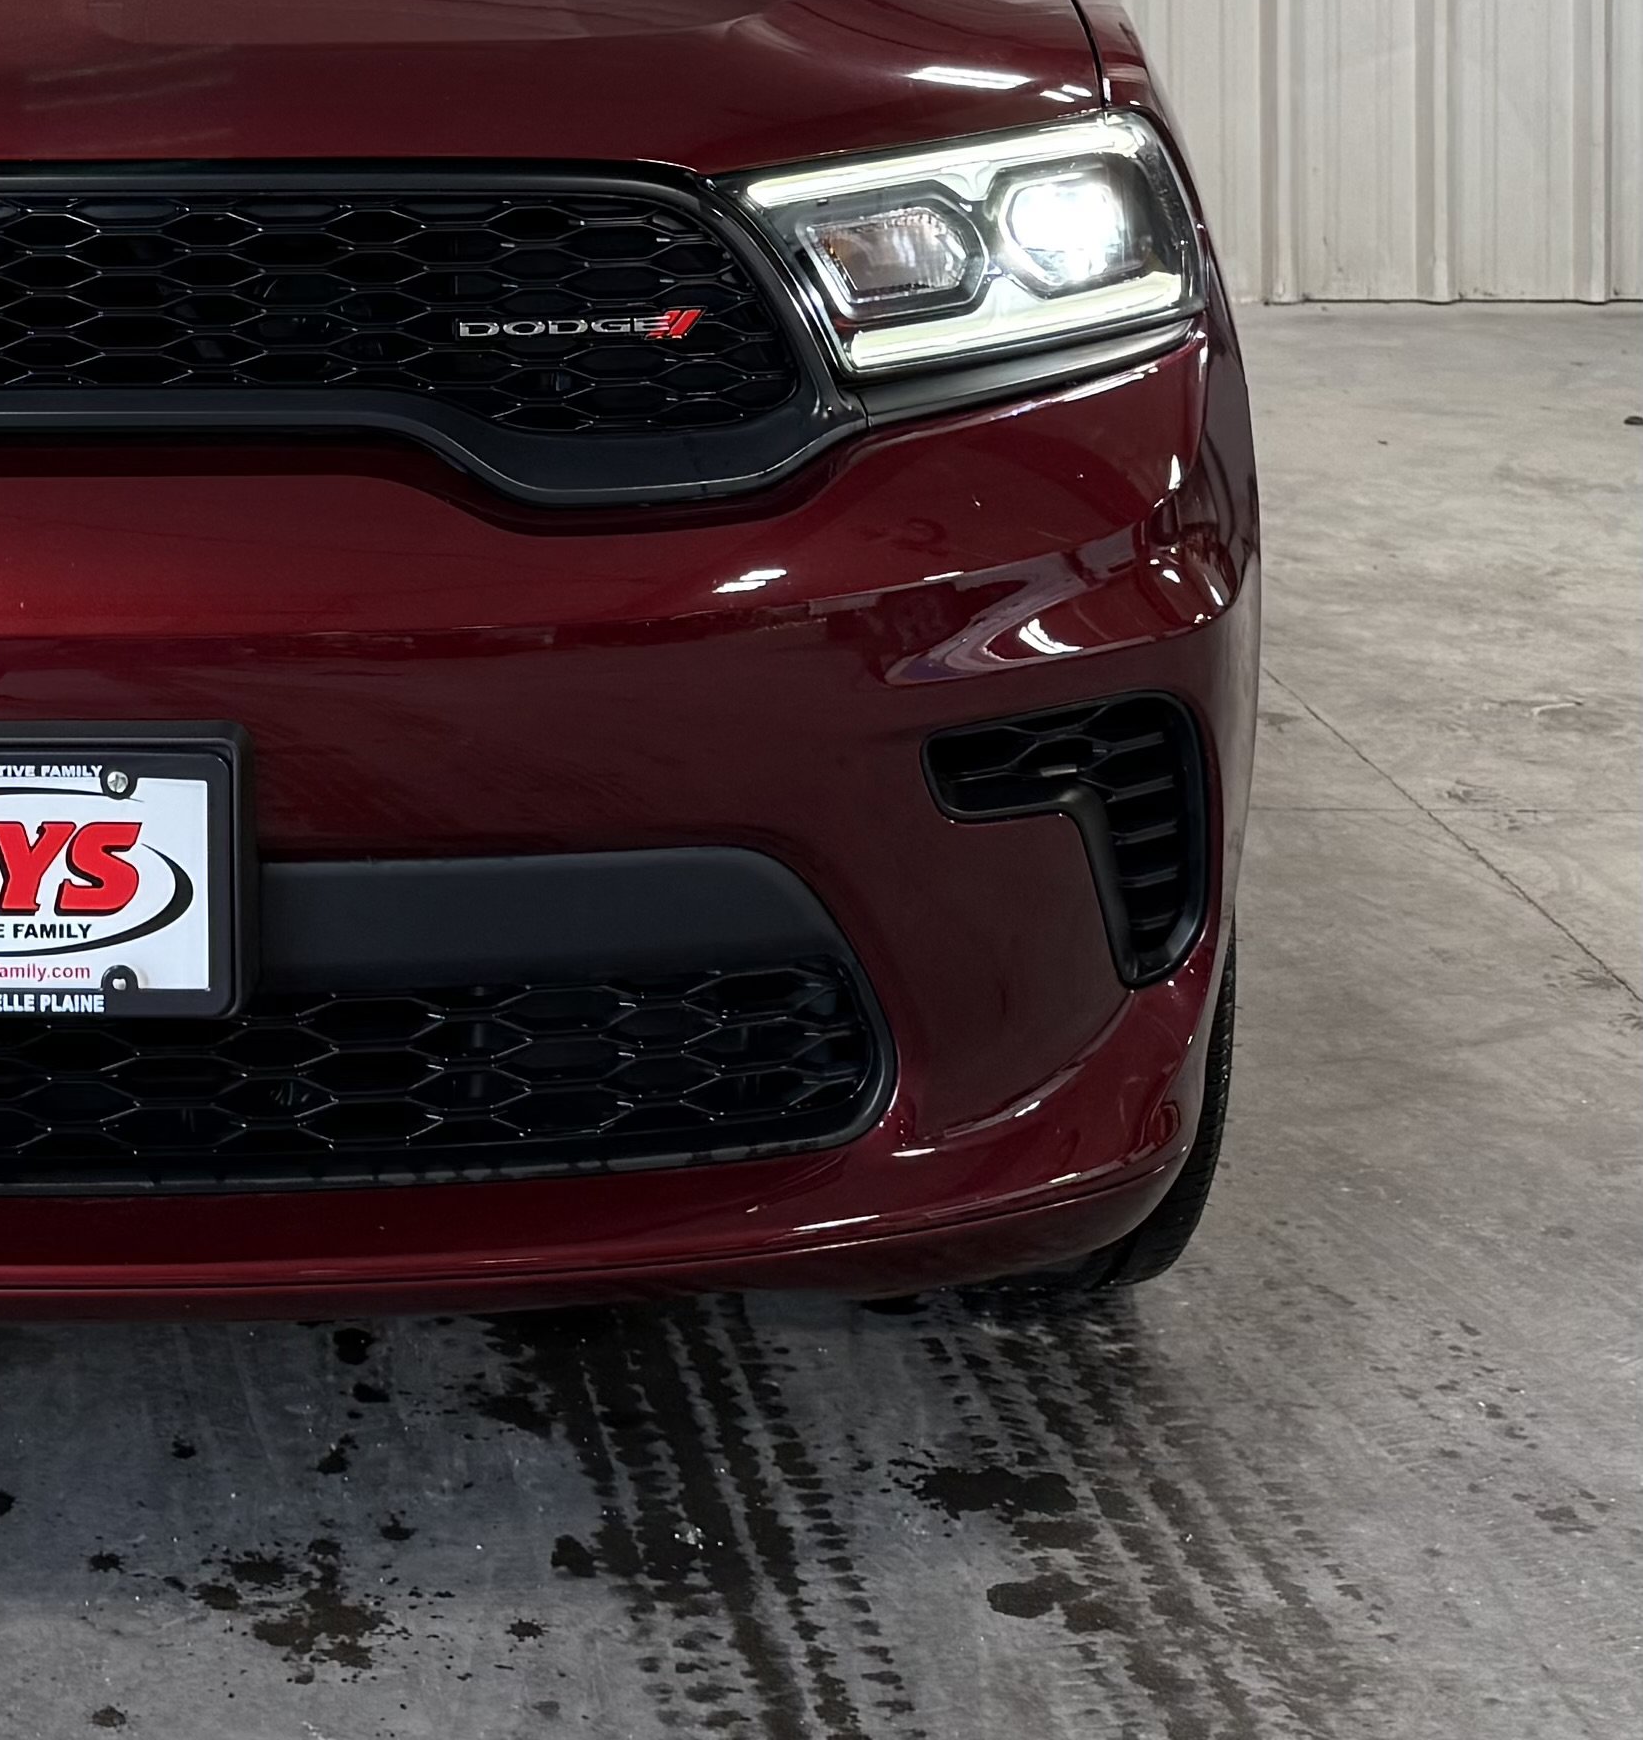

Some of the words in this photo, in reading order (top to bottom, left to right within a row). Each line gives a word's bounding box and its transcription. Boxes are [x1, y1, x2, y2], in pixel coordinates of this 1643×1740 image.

[459, 316, 672, 338] DODGE
[40, 764, 103, 778] FAMILY
[12, 923, 92, 940] FAMILY
[39, 993, 105, 1013] PLAINE
